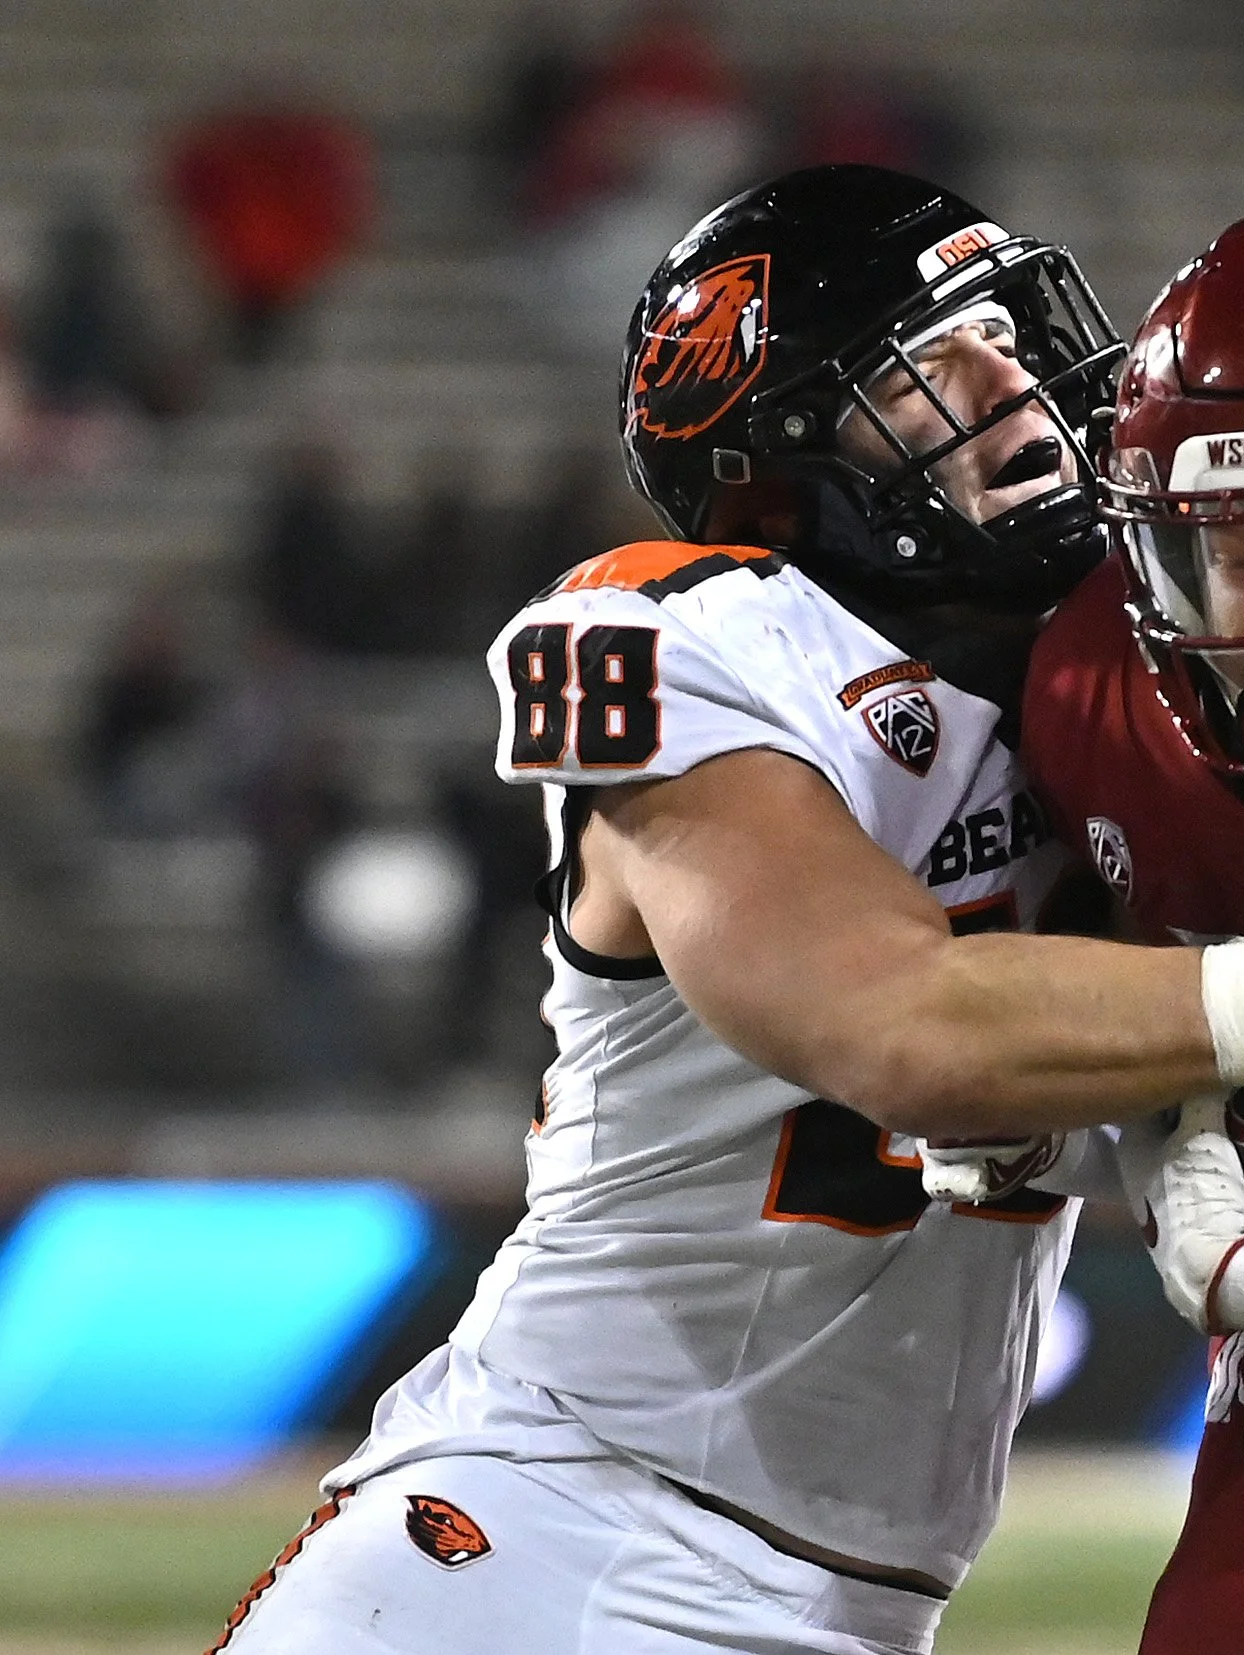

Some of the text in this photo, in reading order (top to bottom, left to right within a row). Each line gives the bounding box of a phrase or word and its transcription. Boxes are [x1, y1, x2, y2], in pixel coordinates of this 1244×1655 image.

[936, 228, 992, 268] OSU
[507, 622, 663, 769] 88
[868, 691, 937, 750] PAC
[894, 724, 932, 761] 12
